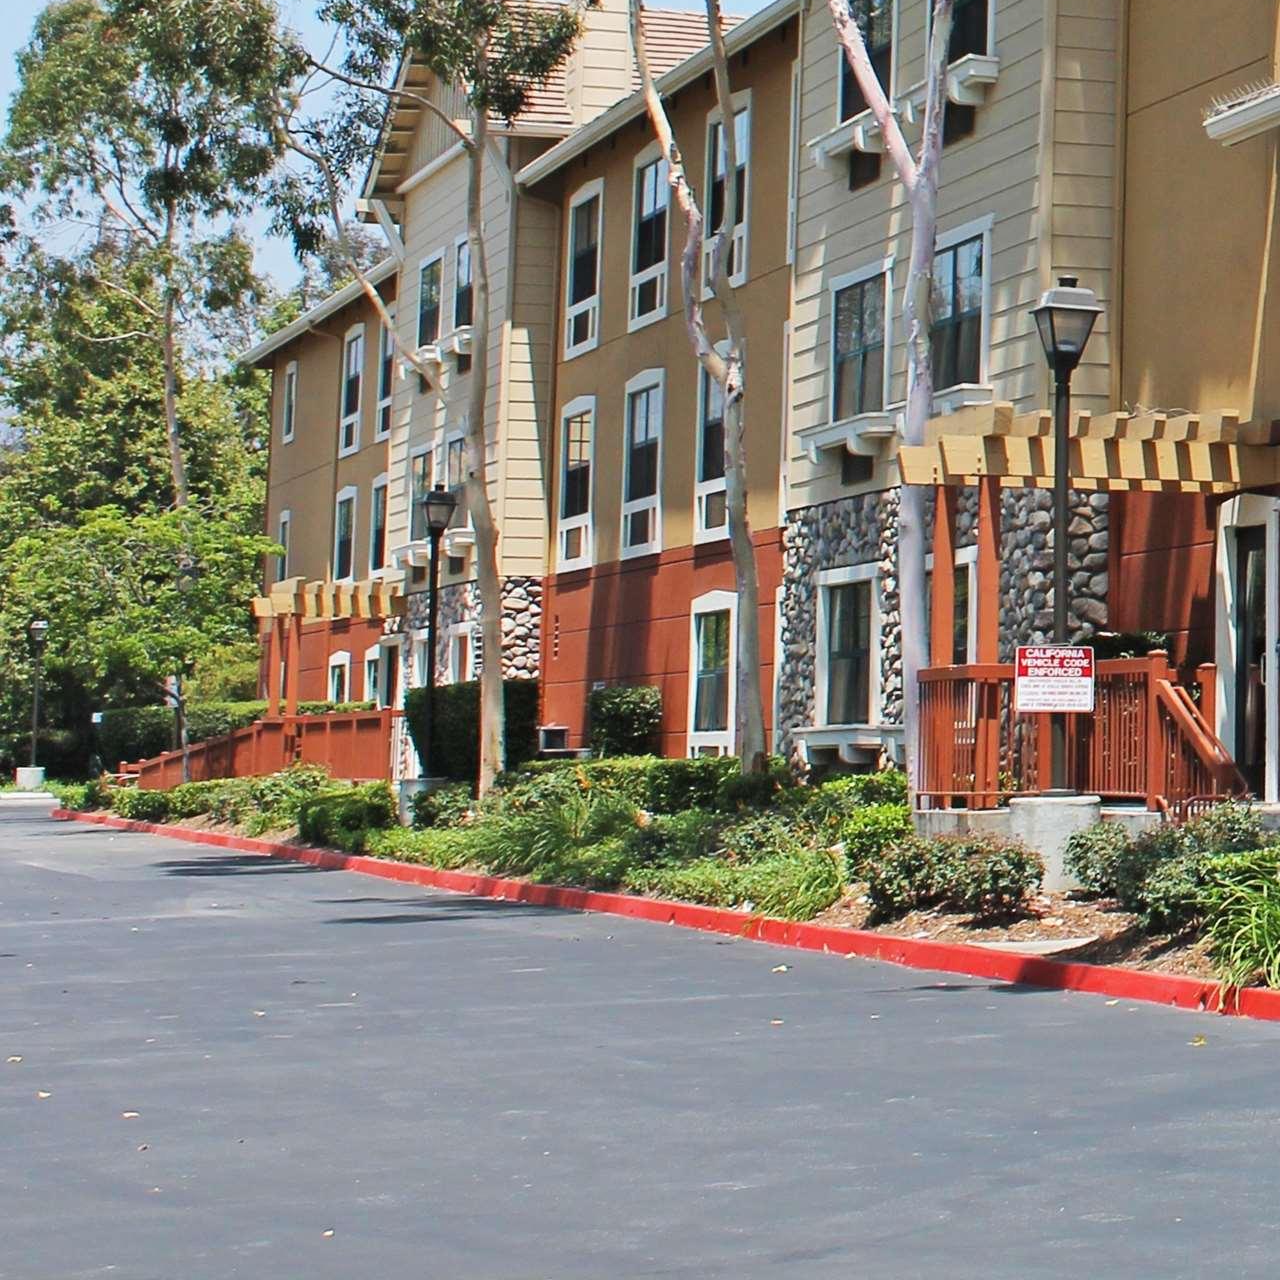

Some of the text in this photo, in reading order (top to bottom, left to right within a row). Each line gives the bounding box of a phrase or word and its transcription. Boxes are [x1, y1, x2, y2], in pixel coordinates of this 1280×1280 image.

[1025, 648, 1085, 658] CALIFORNIA
[1021, 658, 1090, 667] VEHICLE CODE
[1028, 667, 1082, 677] ENFORCED
